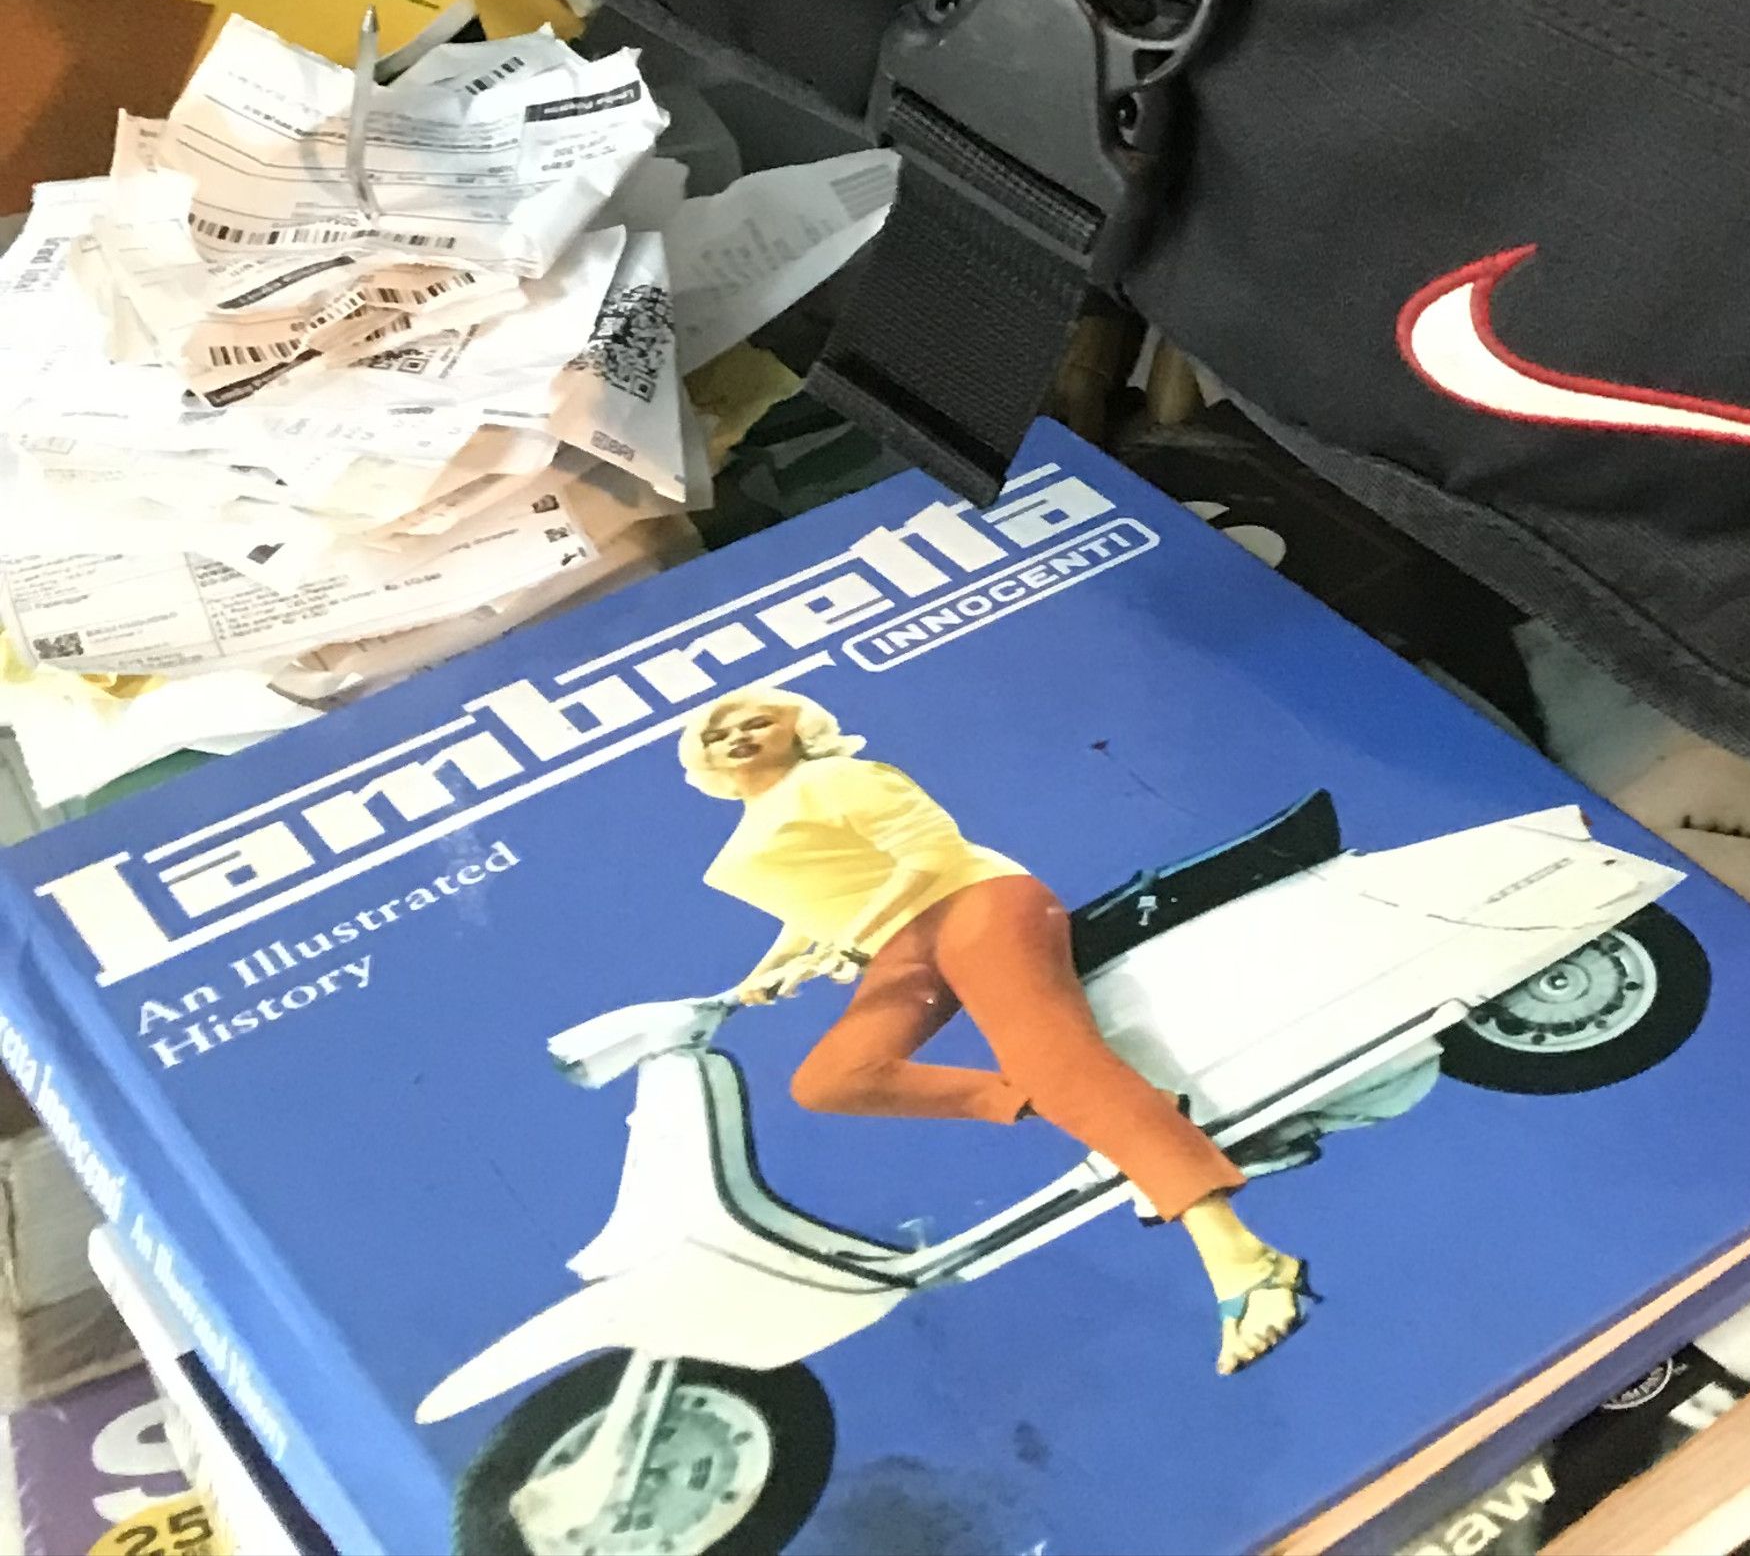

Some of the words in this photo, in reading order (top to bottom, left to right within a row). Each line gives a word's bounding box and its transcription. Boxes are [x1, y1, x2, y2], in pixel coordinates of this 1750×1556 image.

[871, 531, 1131, 656] INNOCENTI
[138, 984, 222, 1037] An
[228, 840, 521, 989] Illustrated
[149, 953, 373, 1070] History
